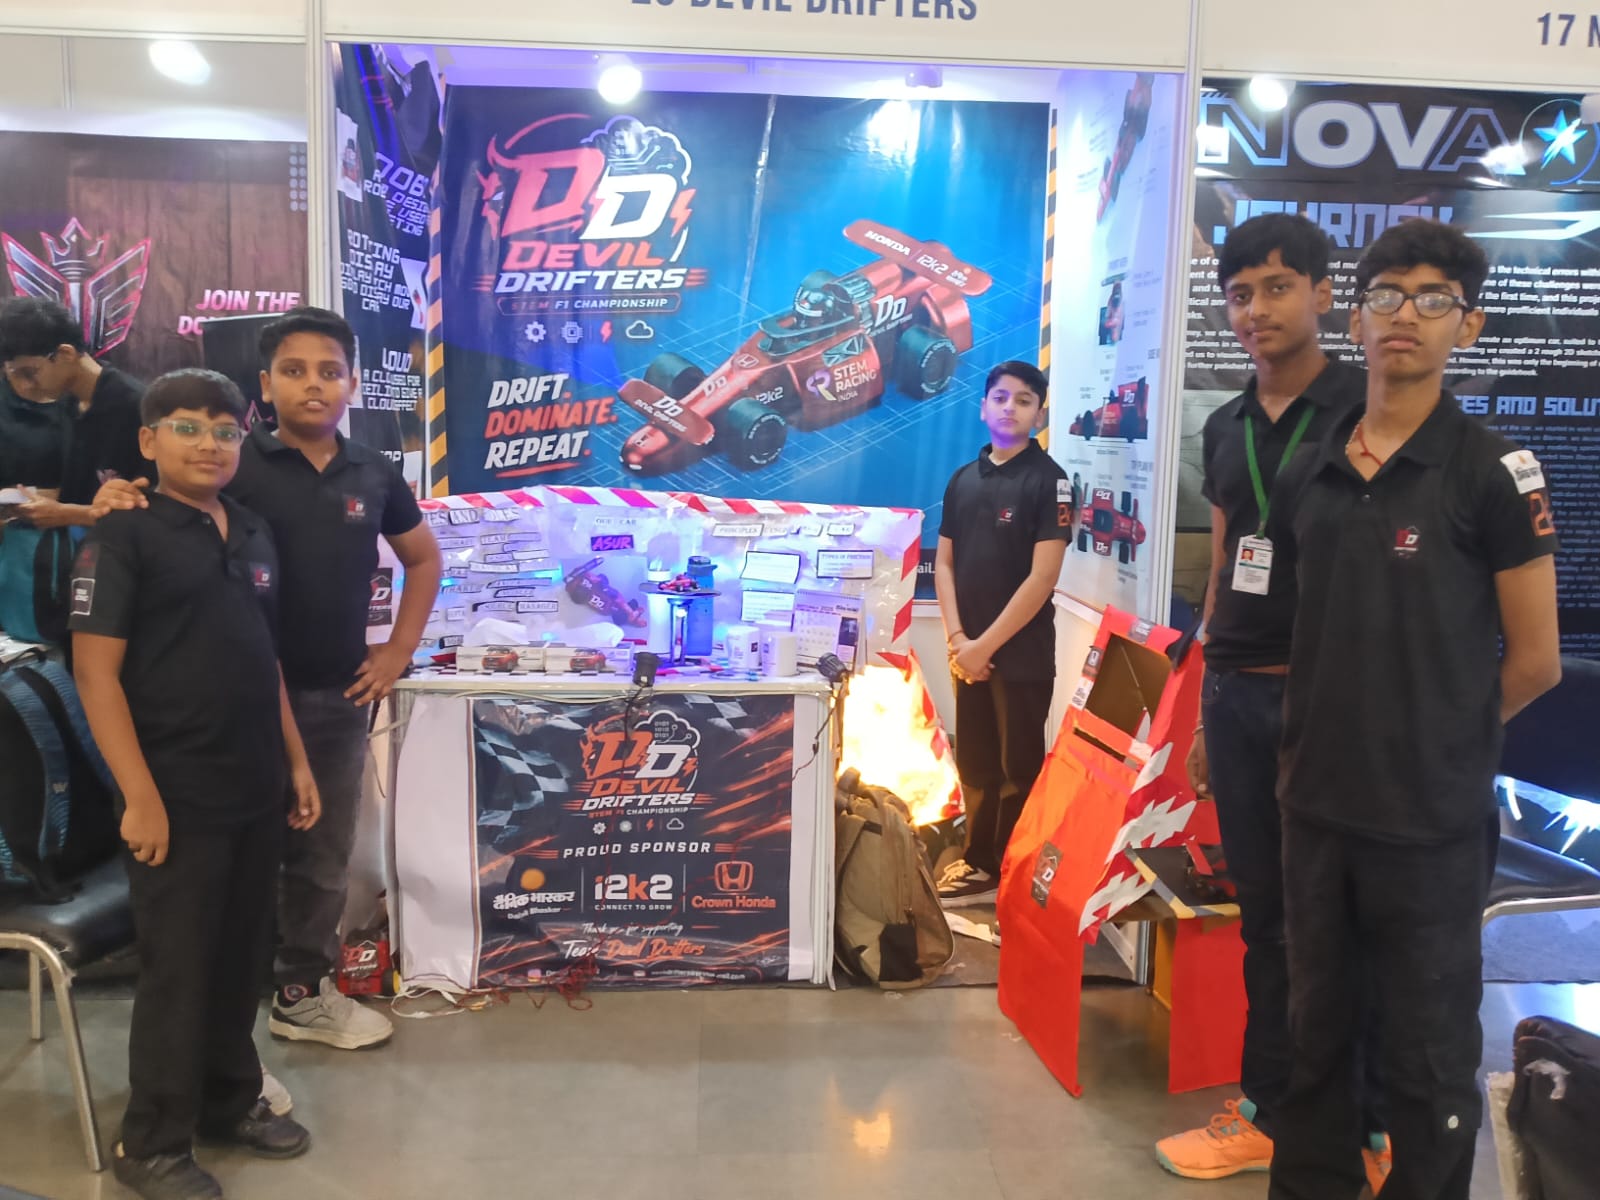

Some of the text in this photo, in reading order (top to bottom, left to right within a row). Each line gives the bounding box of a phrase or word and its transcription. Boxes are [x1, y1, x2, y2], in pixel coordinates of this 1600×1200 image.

[1537, 12, 1576, 46] 17
[1197, 98, 1526, 176] NOVA
[502, 240, 665, 270] DEVIL
[864, 230, 949, 275] HONDA i2k2
[494, 268, 688, 294] DRIFTERS
[195, 289, 301, 312] JOIN THE
[511, 298, 669, 311] STEM F1 CHAMPIONSHIP
[875, 294, 907, 327] DD
[833, 360, 868, 381] STEM
[835, 369, 878, 393] RACING
[487, 373, 572, 408] DRIFT.
[837, 390, 859, 402] INDIA
[654, 395, 684, 419] DD
[1496, 396, 1537, 415] AND
[484, 397, 618, 439] DOMINATE.
[484, 431, 591, 471] REPEAT.
[591, 536, 632, 551] ASUR
[590, 778, 687, 797] DEVIL
[582, 793, 696, 811] DRIFTERS
[626, 807, 689, 816] CHAMPIONSHIP
[563, 842, 711, 859] PROUD SPONSOR
[594, 873, 673, 901] i2k2
[691, 895, 777, 909] Crown Honda
[648, 937, 706, 960] Drifters
